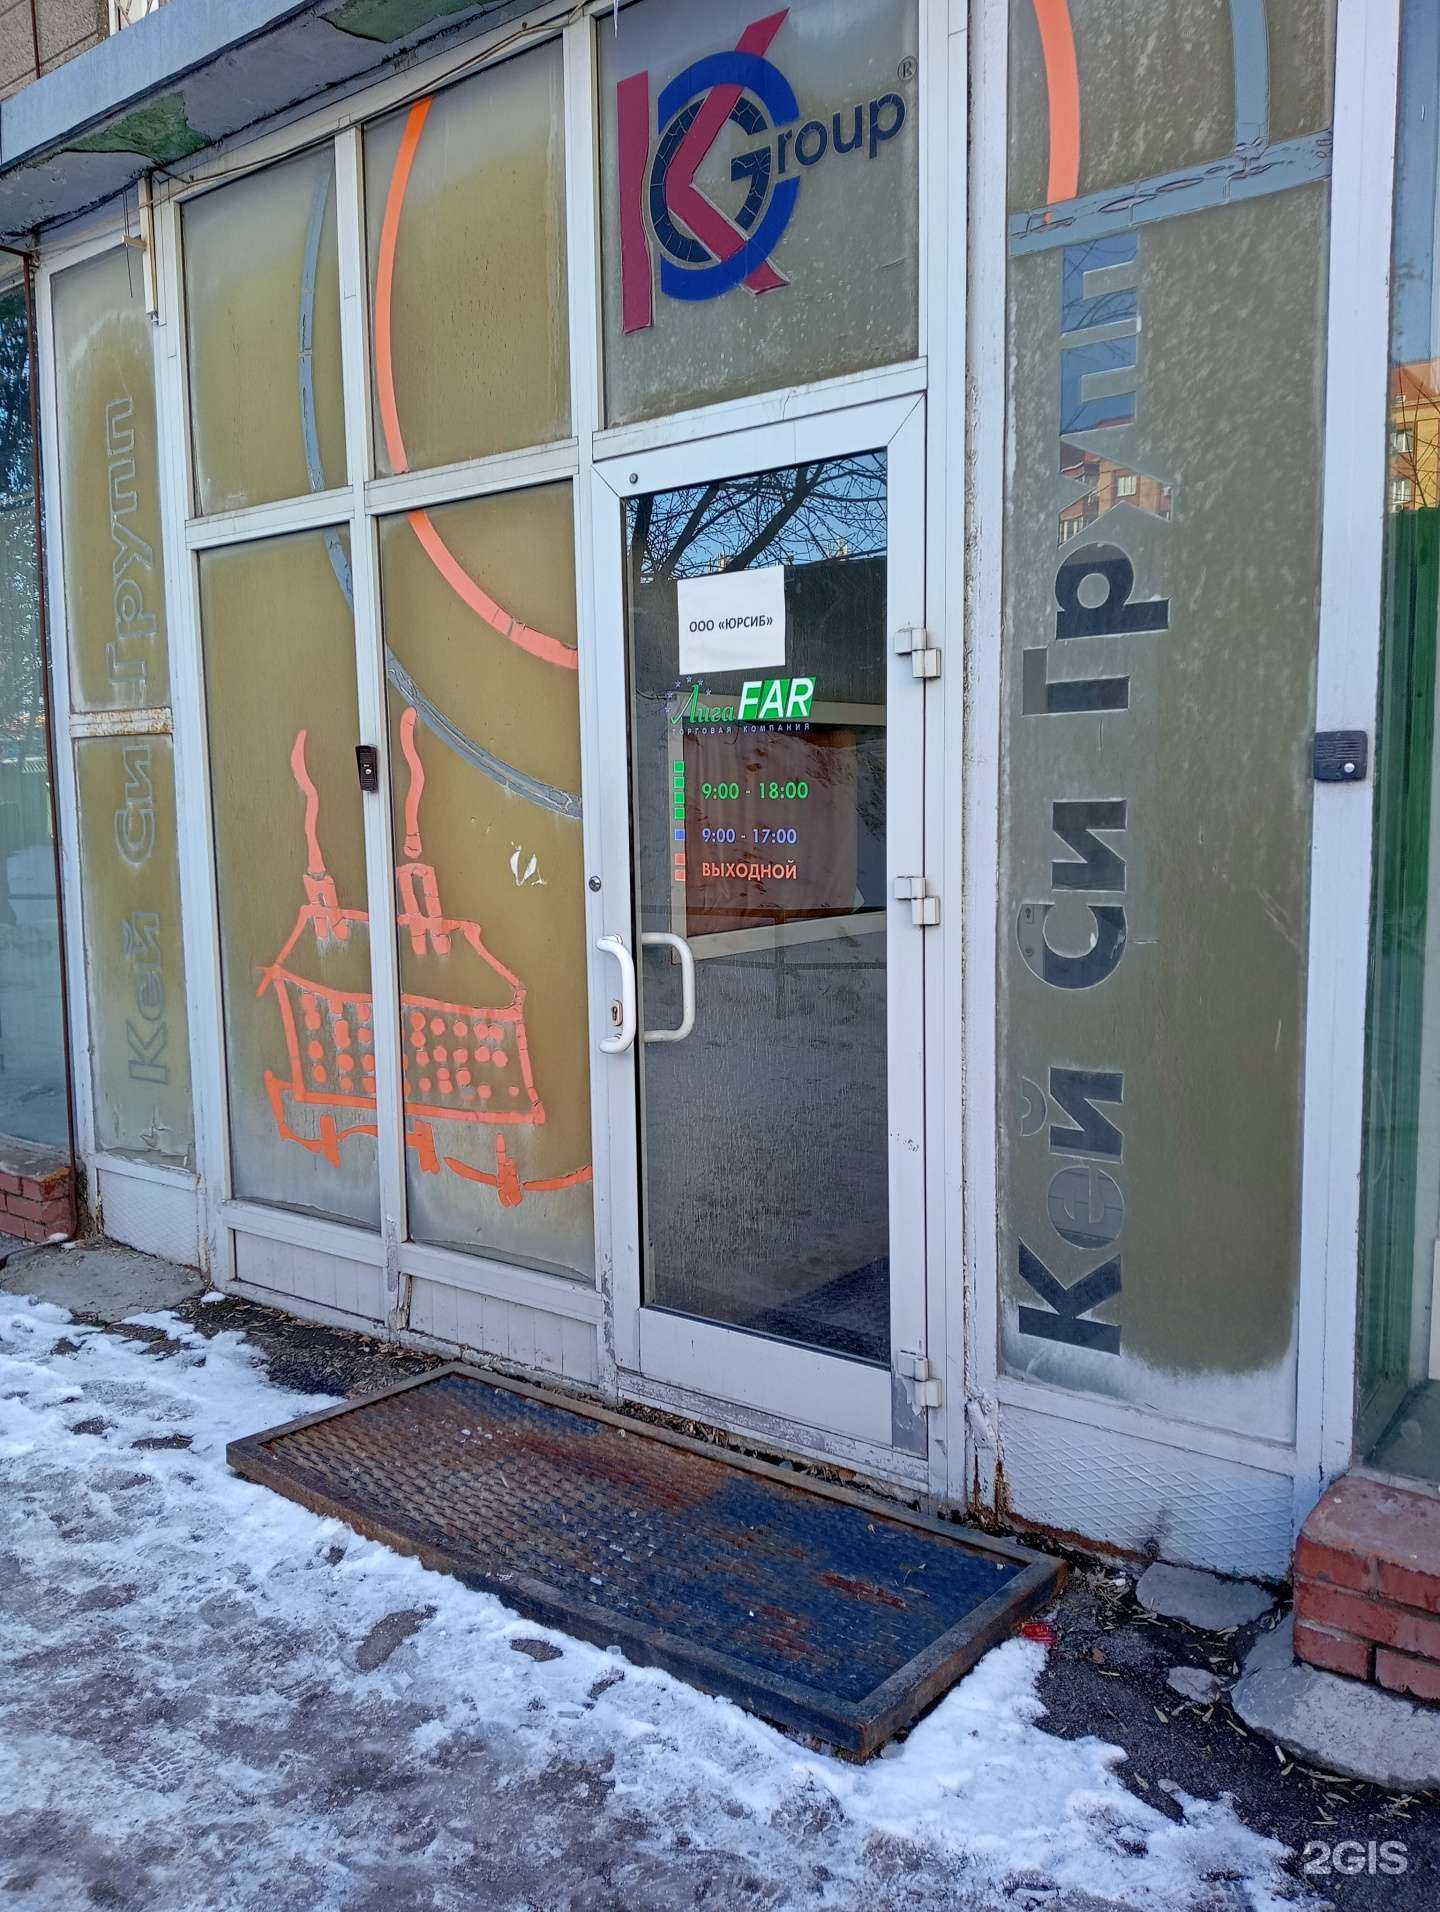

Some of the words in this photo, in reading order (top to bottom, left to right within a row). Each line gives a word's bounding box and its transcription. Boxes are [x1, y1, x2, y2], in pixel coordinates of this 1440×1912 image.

[1021, 231, 1173, 717] Групп
[105, 396, 160, 686] Групп
[689, 619, 715, 633] ООО
[718, 614, 773, 631] «ЮРСИБ»
[671, 683, 734, 724] Лига
[736, 676, 816, 722] FAR
[671, 725, 732, 737] ТОРГОВАЯ
[743, 722, 811, 734] КОМПАНИЯ
[114, 743, 157, 867] Си
[701, 782, 740, 800] 9:00
[758, 780, 809, 800] 18:00
[701, 827, 736, 844] 9:00
[752, 827, 798, 844] 17:00
[701, 858, 798, 881] ВЫХОДНОЙ
[1016, 798, 1128, 991] Си
[119, 911, 169, 1086] Кей
[1017, 1066, 1126, 1356] Кей
